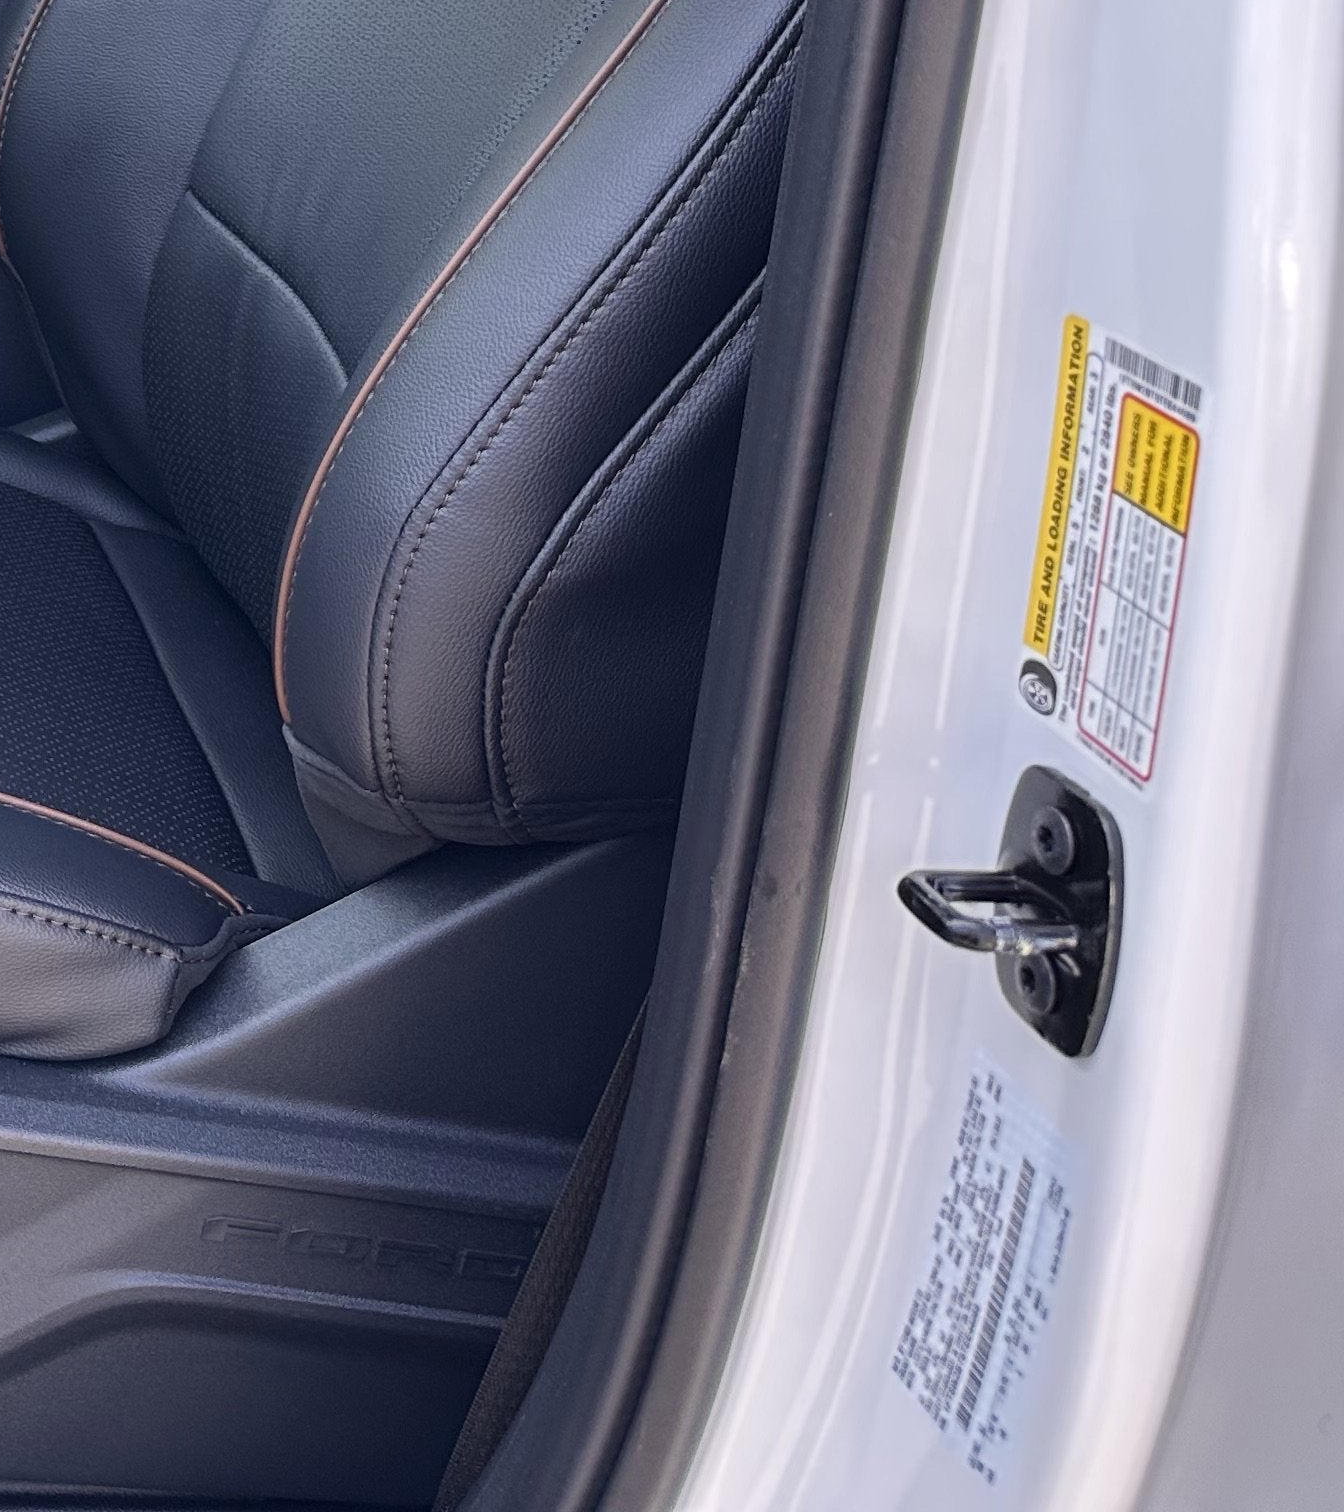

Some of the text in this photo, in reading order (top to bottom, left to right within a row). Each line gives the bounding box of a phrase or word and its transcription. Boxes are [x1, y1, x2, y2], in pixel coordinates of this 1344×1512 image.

[1033, 324, 1084, 644] TIRE AND LOADING INFORMATION
[1124, 471, 1134, 496] SEE
[1139, 419, 1157, 507] MANUAL FOR
[1154, 433, 1174, 513] ADDITIONAL
[1170, 433, 1190, 527] INFORMATION
[201, 1215, 533, 1279] FORD
